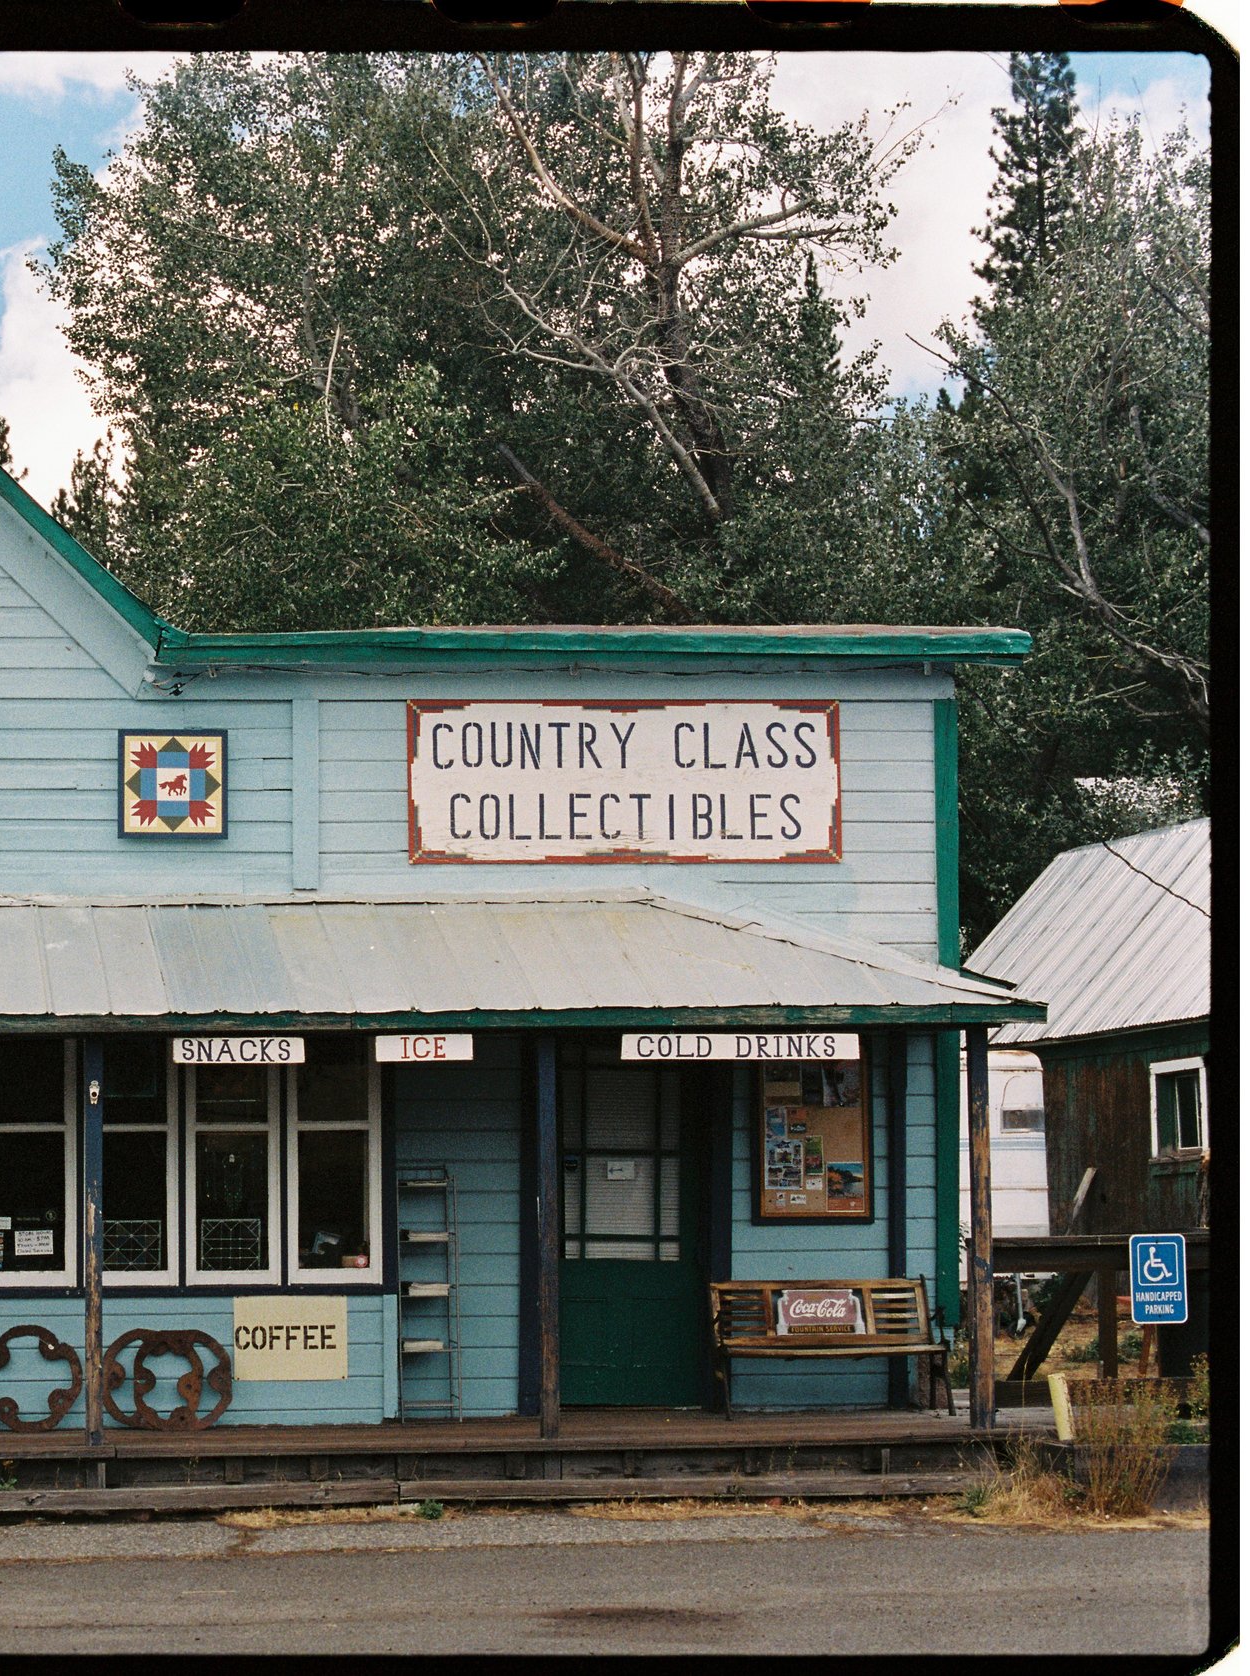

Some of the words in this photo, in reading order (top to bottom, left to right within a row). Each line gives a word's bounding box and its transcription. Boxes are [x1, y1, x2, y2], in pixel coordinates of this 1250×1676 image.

[432, 722, 636, 769] COUNTRY
[674, 722, 818, 769] CLASS
[450, 793, 803, 840] COLLECTIBLES
[181, 1039, 291, 1062] SNACKS
[400, 1036, 447, 1059] ICE
[637, 1035, 713, 1058] COLD
[736, 1035, 836, 1058] DRINKS
[1136, 1291, 1182, 1302] HANDICAPPED
[790, 1299, 846, 1318] Coca-Cola
[1145, 1304, 1174, 1315] PARKING
[235, 1324, 337, 1351] COFFEE
